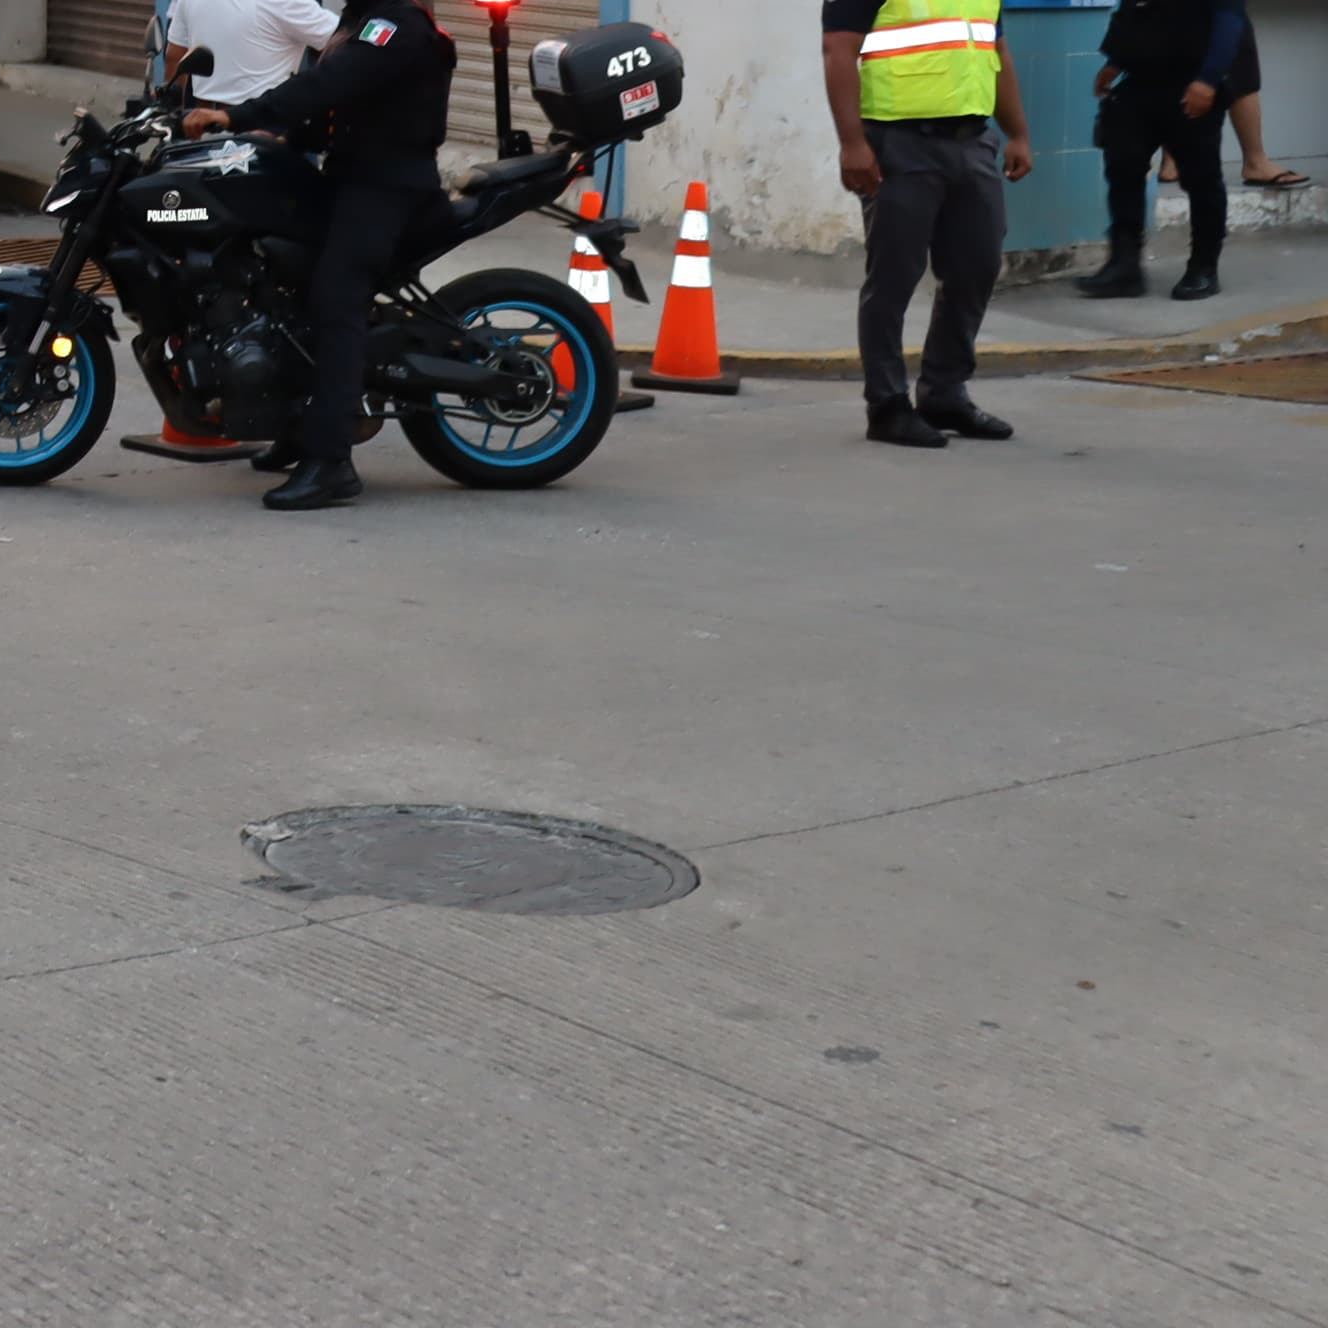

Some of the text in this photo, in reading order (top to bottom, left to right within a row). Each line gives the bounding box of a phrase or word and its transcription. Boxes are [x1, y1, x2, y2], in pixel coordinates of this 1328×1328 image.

[607, 46, 652, 77] 473
[624, 83, 654, 103] 911
[147, 207, 209, 223] POLICIA ESTATAL
